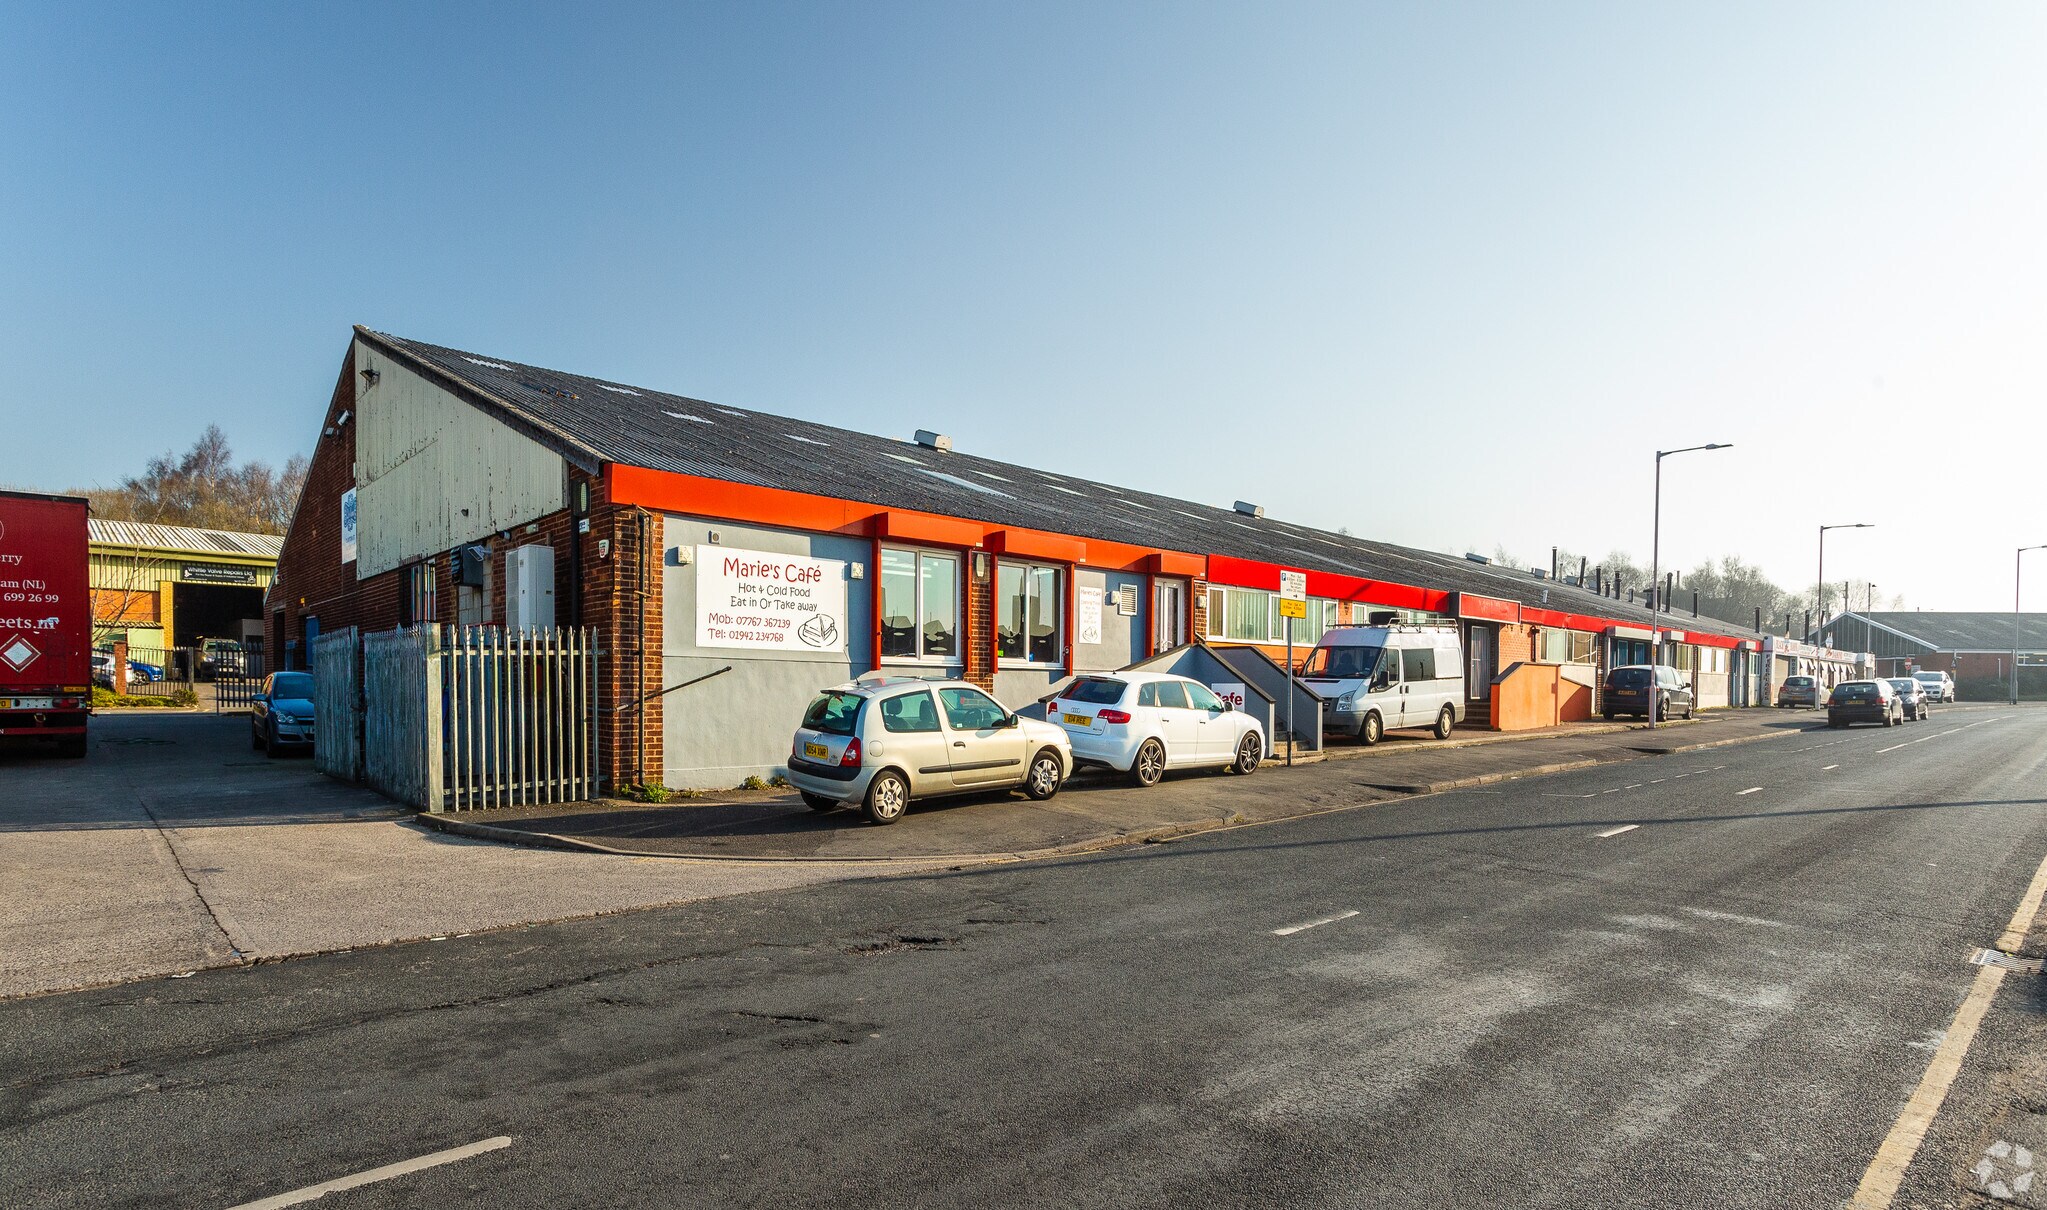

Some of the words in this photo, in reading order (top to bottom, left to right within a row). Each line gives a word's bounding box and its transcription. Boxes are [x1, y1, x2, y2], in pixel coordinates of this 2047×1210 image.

[0, 554, 23, 566] rry
[723, 557, 780, 579] Marie's
[785, 563, 822, 584] Café
[22, 579, 46, 591] (NL)
[738, 582, 757, 594] Hot
[759, 584, 765, 594] &
[766, 584, 788, 596] Cold
[789, 586, 811, 598] Food
[3, 592, 25, 602] 699
[28, 593, 42, 603] 26
[44, 593, 59, 603] 99
[730, 595, 747, 607] Eat
[749, 597, 757, 607] in
[759, 598, 771, 610] Or
[773, 600, 796, 610] Take
[797, 602, 818, 612] away
[708, 612, 734, 625] Mob:
[736, 616, 762, 627] 07767
[707, 627, 726, 640] Tel:
[728, 630, 754, 641] 01942
[755, 631, 784, 642] 234768
